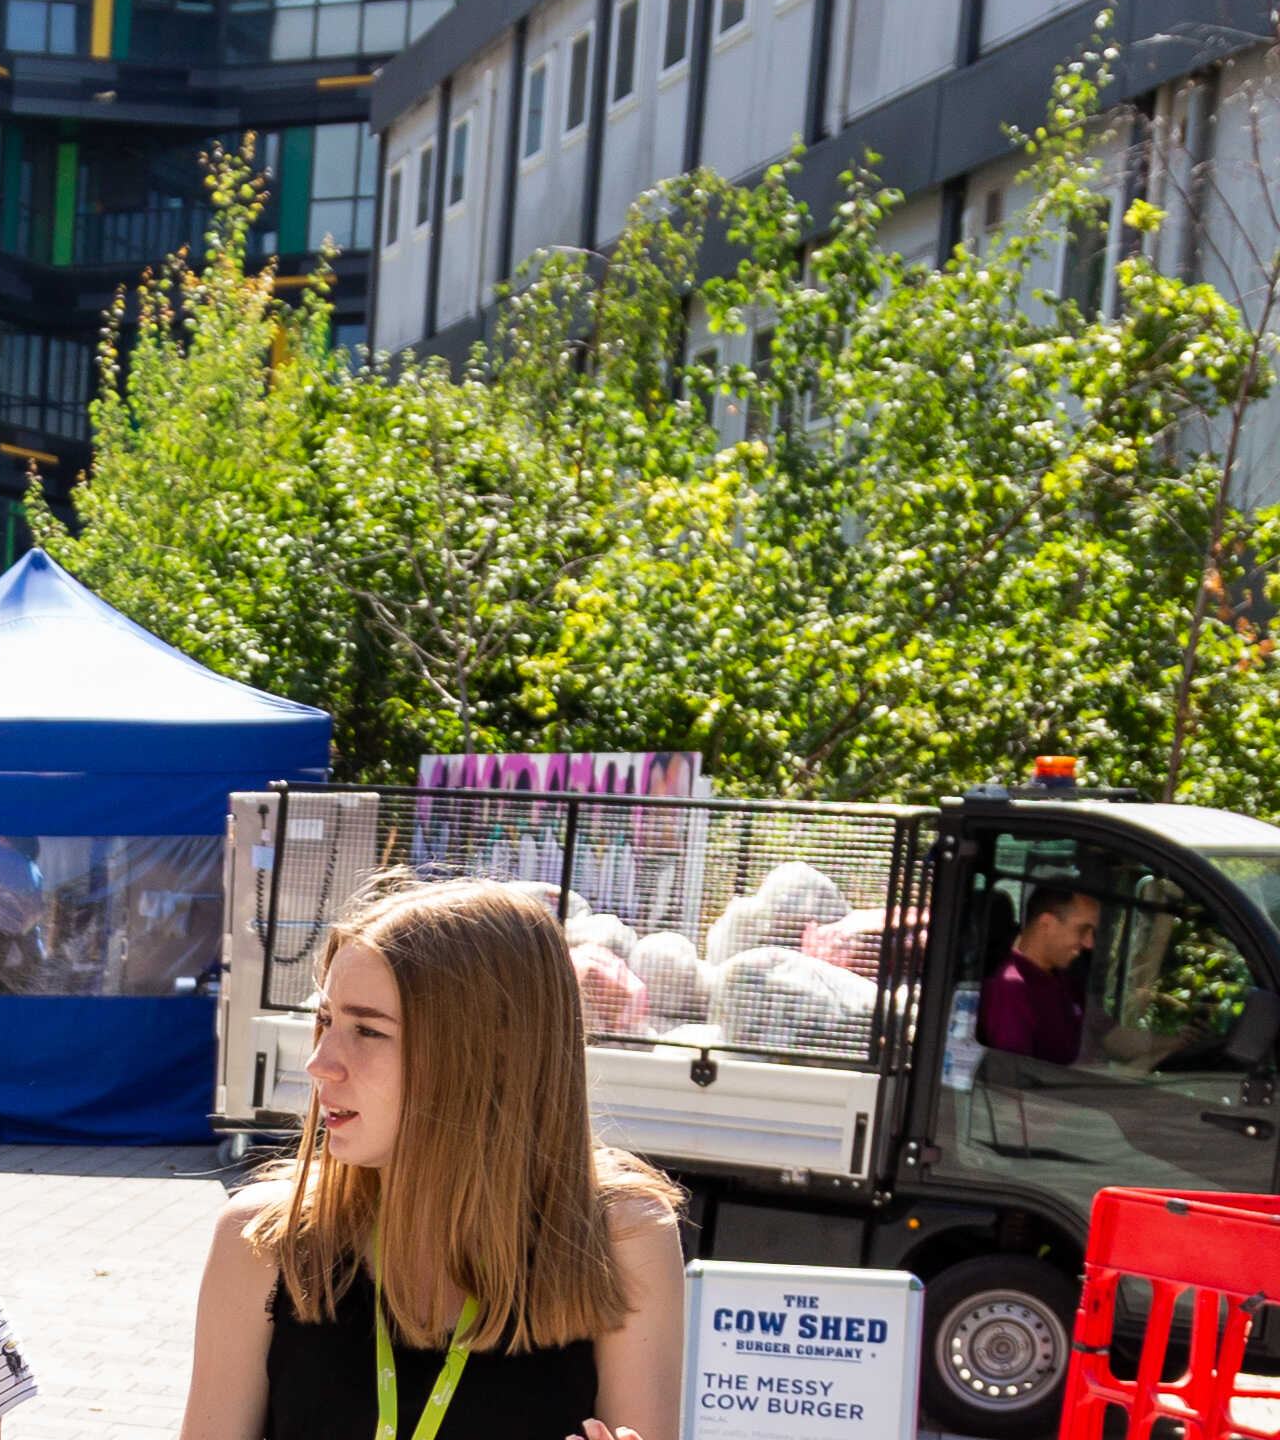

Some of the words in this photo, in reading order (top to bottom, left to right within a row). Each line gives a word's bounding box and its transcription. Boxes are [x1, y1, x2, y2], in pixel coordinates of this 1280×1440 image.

[783, 1294, 819, 1309] THE
[713, 1308, 787, 1336] COW
[798, 1314, 888, 1344] SHED
[736, 1339, 791, 1354] BURGER
[796, 1344, 862, 1359] COMPANY
[703, 1372, 748, 1391] THE
[757, 1376, 834, 1397] MESSY
[701, 1393, 759, 1411] COW
[767, 1397, 864, 1420] BURGER
